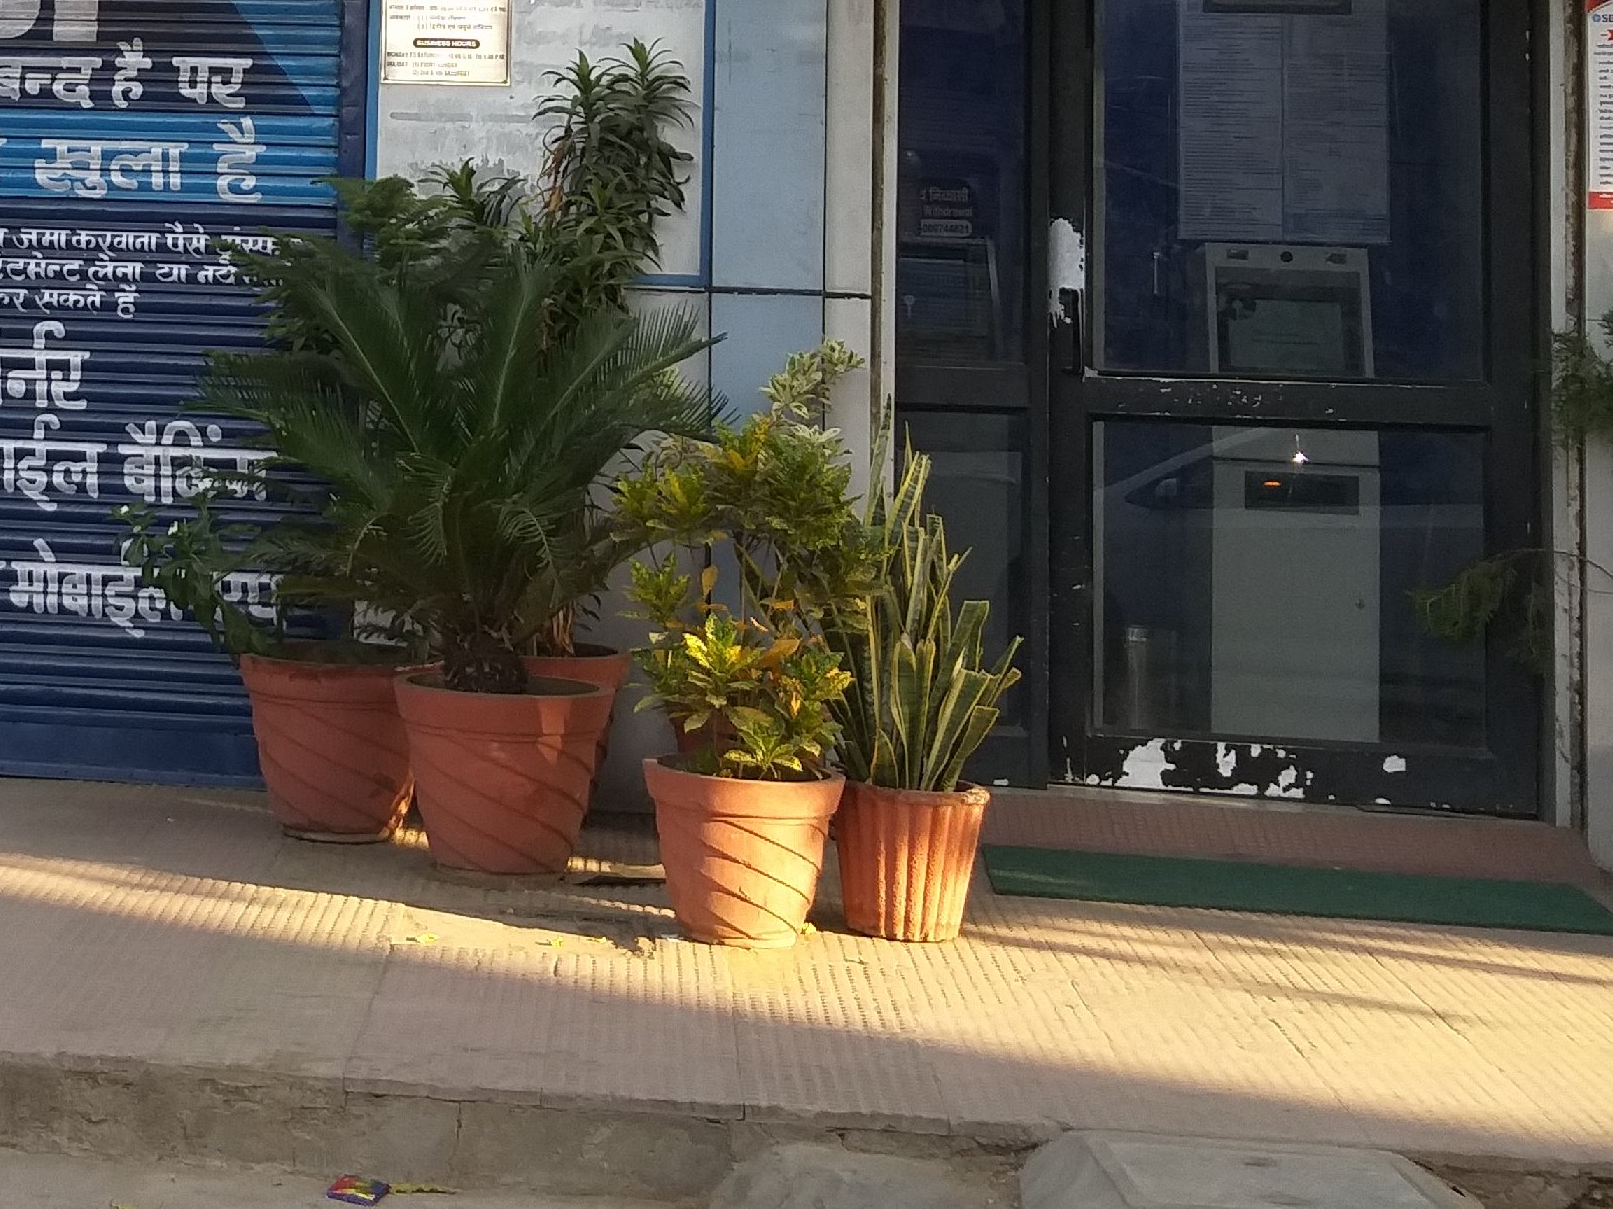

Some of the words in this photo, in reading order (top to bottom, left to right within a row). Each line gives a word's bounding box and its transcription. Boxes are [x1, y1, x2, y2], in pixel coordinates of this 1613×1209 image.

[112, 37, 152, 108] है
[172, 57, 253, 108] पर
[34, 138, 189, 197] खुला
[213, 116, 267, 203] है
[12, 227, 71, 250] जमा
[72, 229, 162, 257] करवाना
[164, 221, 211, 258] पैसे
[88, 253, 145, 284] लेना
[155, 263, 190, 285] या
[35, 283, 107, 314] सकते
